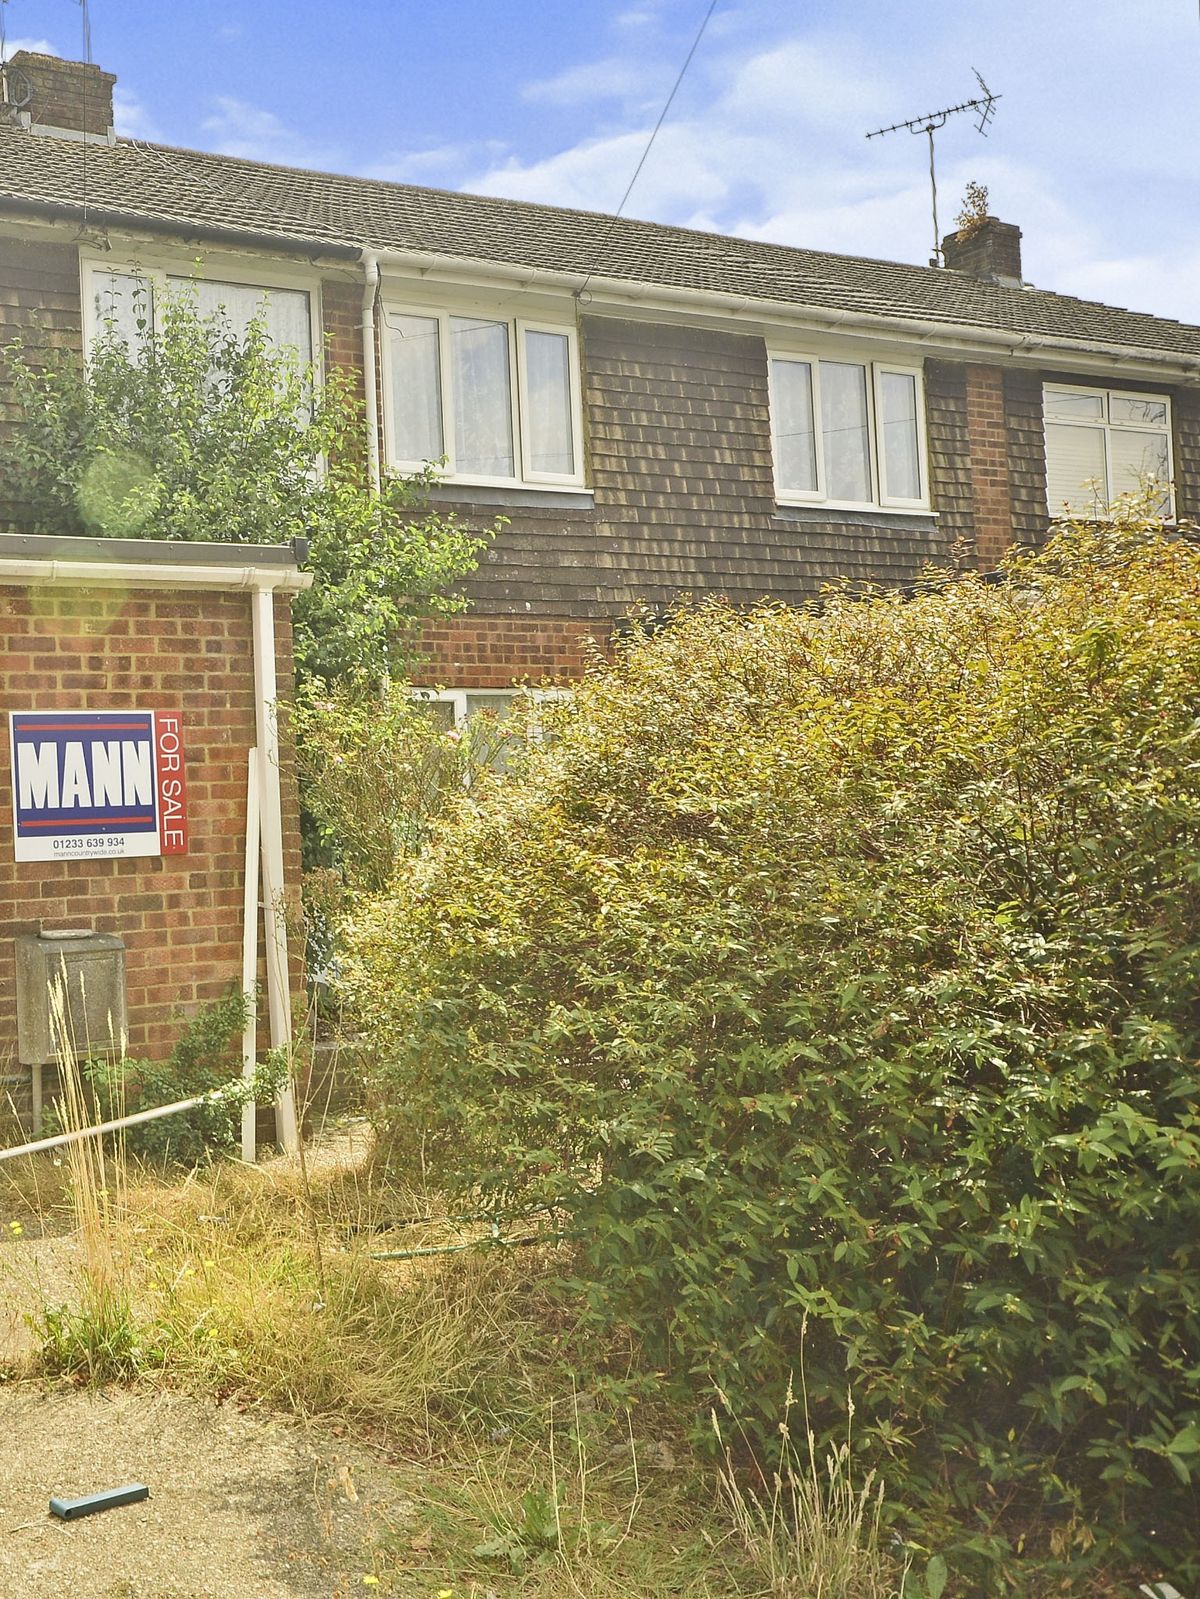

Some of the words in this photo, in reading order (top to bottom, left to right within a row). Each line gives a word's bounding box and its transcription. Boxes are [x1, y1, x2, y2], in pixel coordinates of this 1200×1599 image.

[159, 718, 180, 772] FOR
[17, 741, 152, 809] MANN
[161, 779, 184, 847] SALE
[53, 838, 84, 849] 01233
[86, 838, 105, 848] 639
[107, 837, 125, 847] 934
[53, 849, 125, 857] manncountrywide.co.uk
